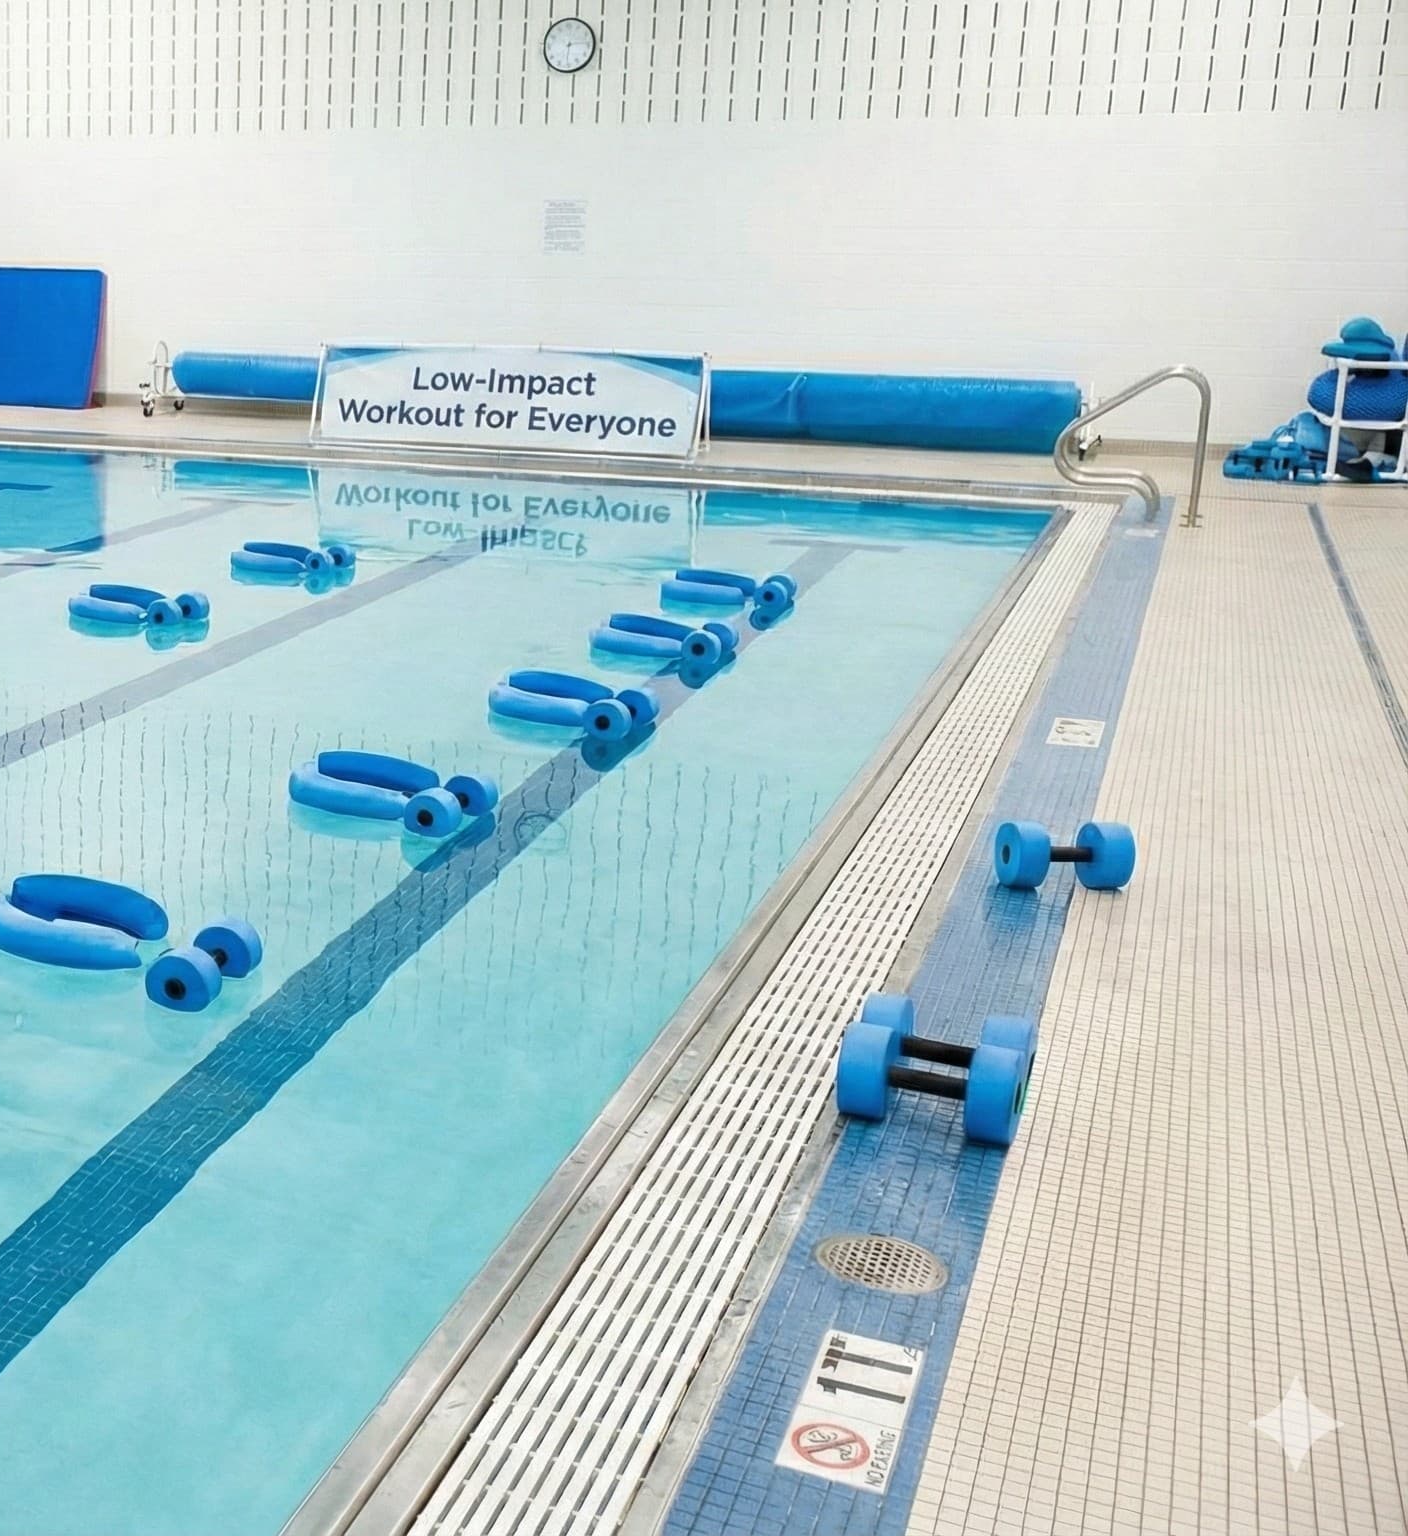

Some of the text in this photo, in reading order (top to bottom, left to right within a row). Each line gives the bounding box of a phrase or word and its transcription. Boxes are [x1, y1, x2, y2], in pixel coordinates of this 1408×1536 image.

[412, 366, 596, 400] Low-Impact
[339, 399, 677, 440] Workout for Everyone
